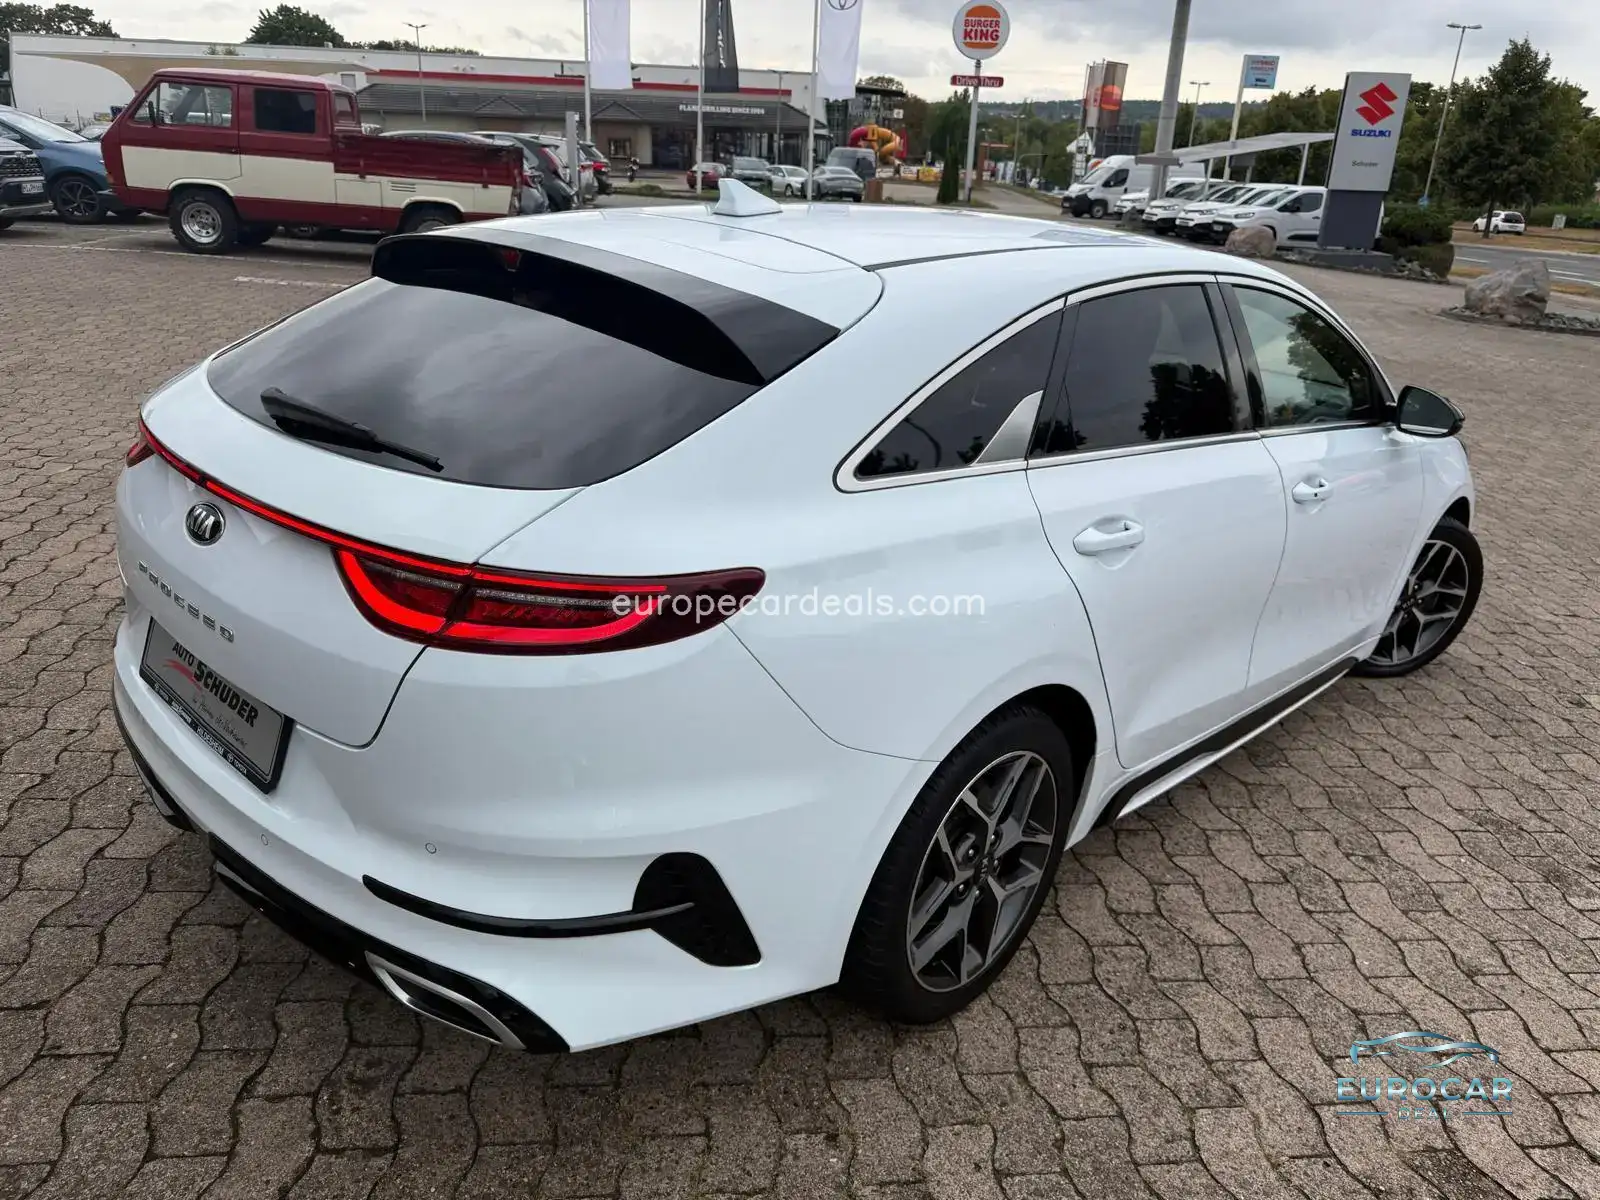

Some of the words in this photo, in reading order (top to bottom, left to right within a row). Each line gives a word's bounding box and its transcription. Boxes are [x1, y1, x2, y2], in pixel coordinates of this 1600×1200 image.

[964, 19, 1000, 28] BURGER
[963, 28, 1000, 41] KING
[956, 76, 978, 86] Drive
[980, 77, 1000, 87] Thru
[1351, 129, 1392, 138] SUZUKI
[138, 559, 235, 643] PROCEED
[172, 641, 196, 667] AUTO
[193, 660, 259, 728] SCHUDER
